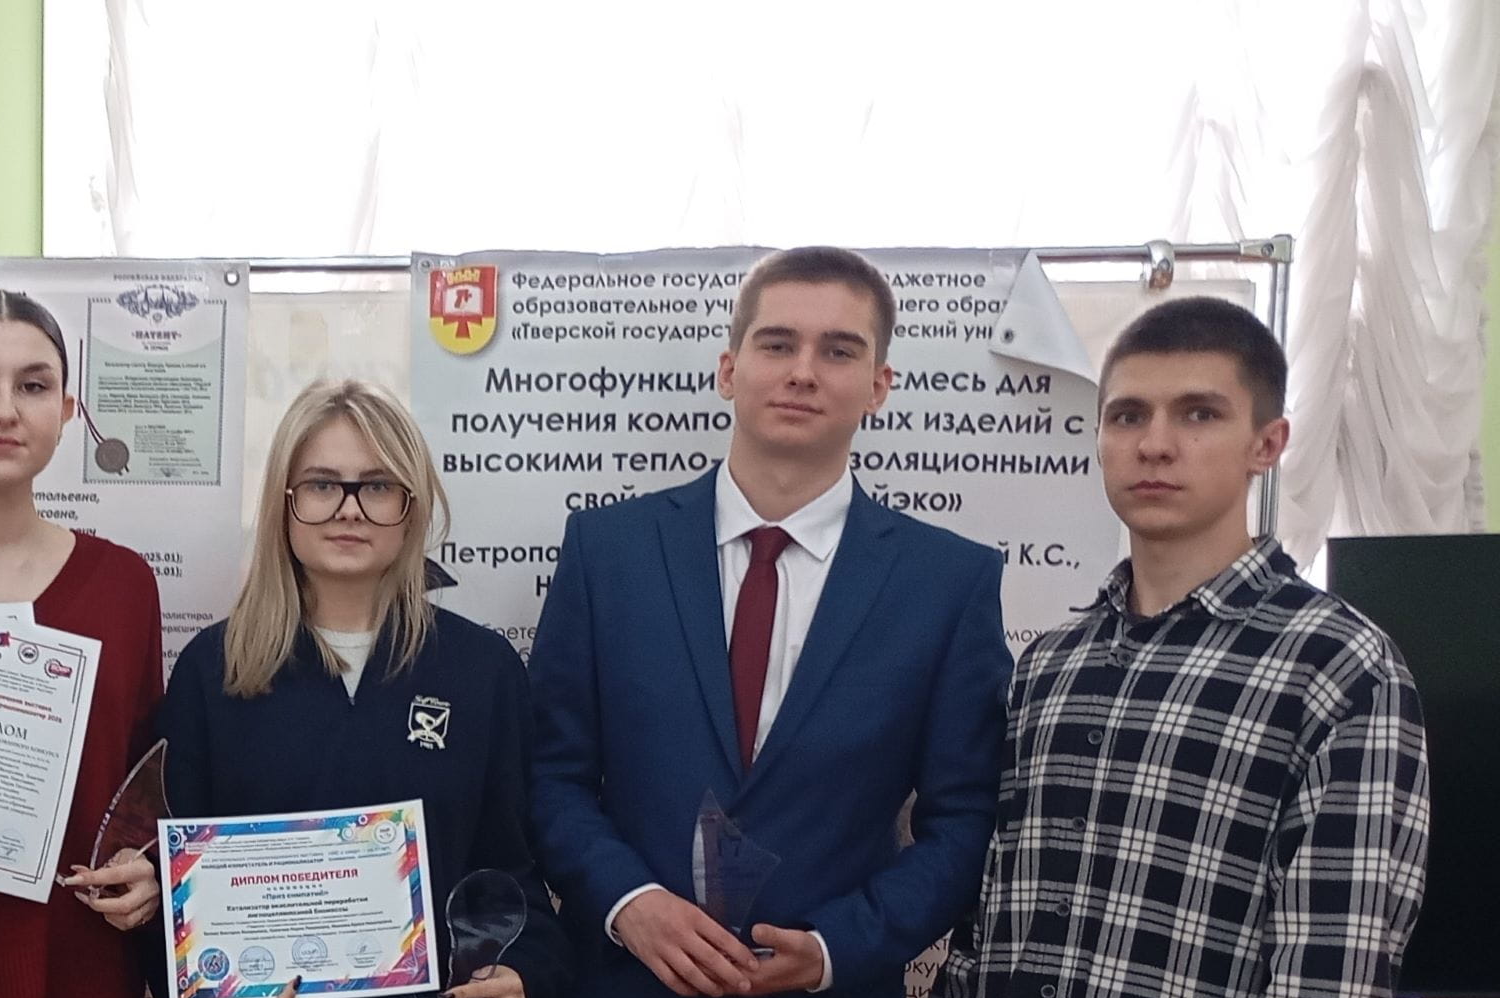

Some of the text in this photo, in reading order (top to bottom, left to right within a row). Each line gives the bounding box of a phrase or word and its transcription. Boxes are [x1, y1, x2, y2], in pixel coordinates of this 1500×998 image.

[512, 271, 656, 291] Федеральное
[886, 272, 986, 289] джетное
[512, 297, 698, 317] образовательное
[897, 298, 940, 313] его
[511, 322, 616, 344] «Тверской
[890, 371, 1051, 396] смесь для
[451, 410, 732, 439] получения компо
[923, 405, 1053, 436] изделий
[1064, 415, 1085, 435] с
[442, 452, 603, 474] высокими
[230, 874, 280, 888] ДИПЛОМ
[281, 868, 359, 884] ПОБЕДИТЕЛЯ
